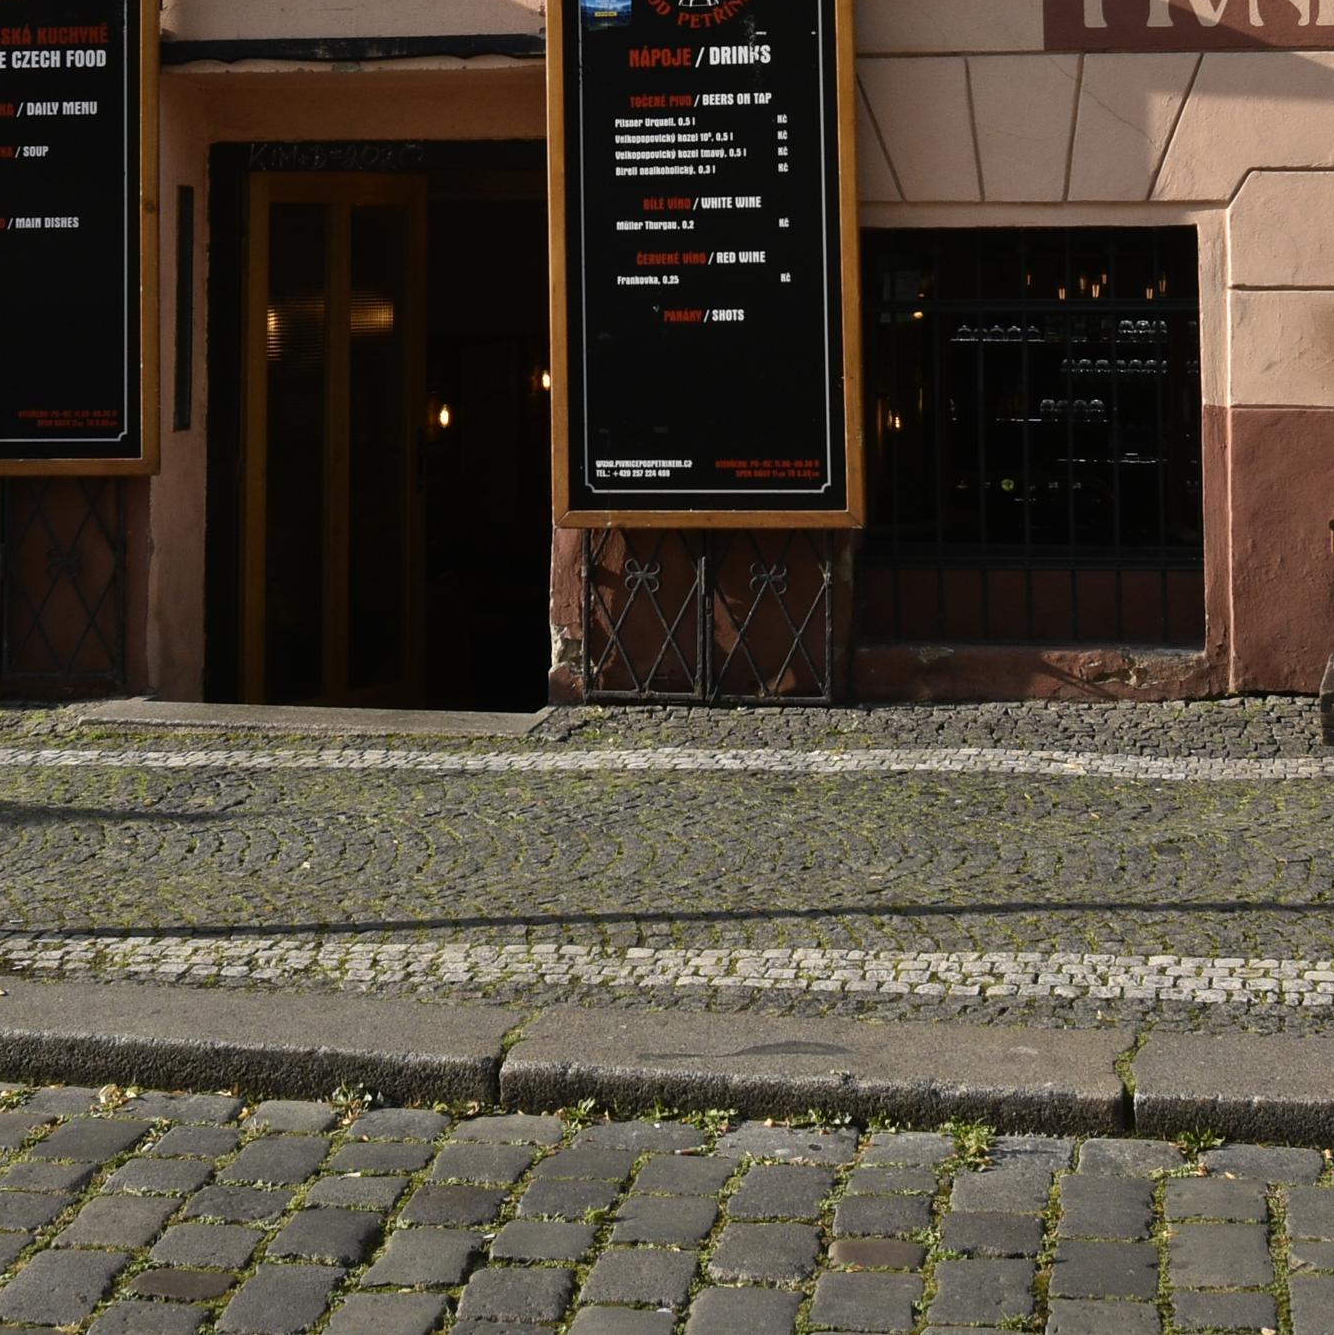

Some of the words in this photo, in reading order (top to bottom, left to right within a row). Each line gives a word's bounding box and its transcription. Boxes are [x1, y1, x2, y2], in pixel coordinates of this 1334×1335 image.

[11, 50, 61, 69] CZECH
[65, 49, 107, 68] FOOD
[628, 45, 693, 68] NÁPOJE
[694, 46, 706, 68] /
[708, 44, 772, 66] DRINKS
[702, 93, 735, 106] BEERS
[736, 93, 751, 105] ON
[753, 92, 772, 105] TAP
[26, 102, 60, 116] DAILY
[62, 101, 98, 115] MENU
[614, 118, 644, 128] Pilsner
[776, 114, 788, 124] Kč
[614, 133, 676, 144] Velkopopovický
[776, 130, 788, 140] Kč
[22, 146, 49, 157] SOUP
[614, 149, 676, 160] Velkopopovický
[777, 146, 789, 156] Kč
[777, 162, 789, 173] Kč
[700, 196, 733, 209] WHITE
[734, 196, 762, 209] WINE
[15, 217, 42, 229] MAIN
[43, 216, 80, 229] DISHES
[616, 220, 643, 231] Müller
[778, 217, 790, 228] Kč
[716, 251, 736, 264] RED
[738, 251, 766, 263] WINE
[780, 272, 792, 283] Kč
[711, 308, 745, 322] SHOTS
